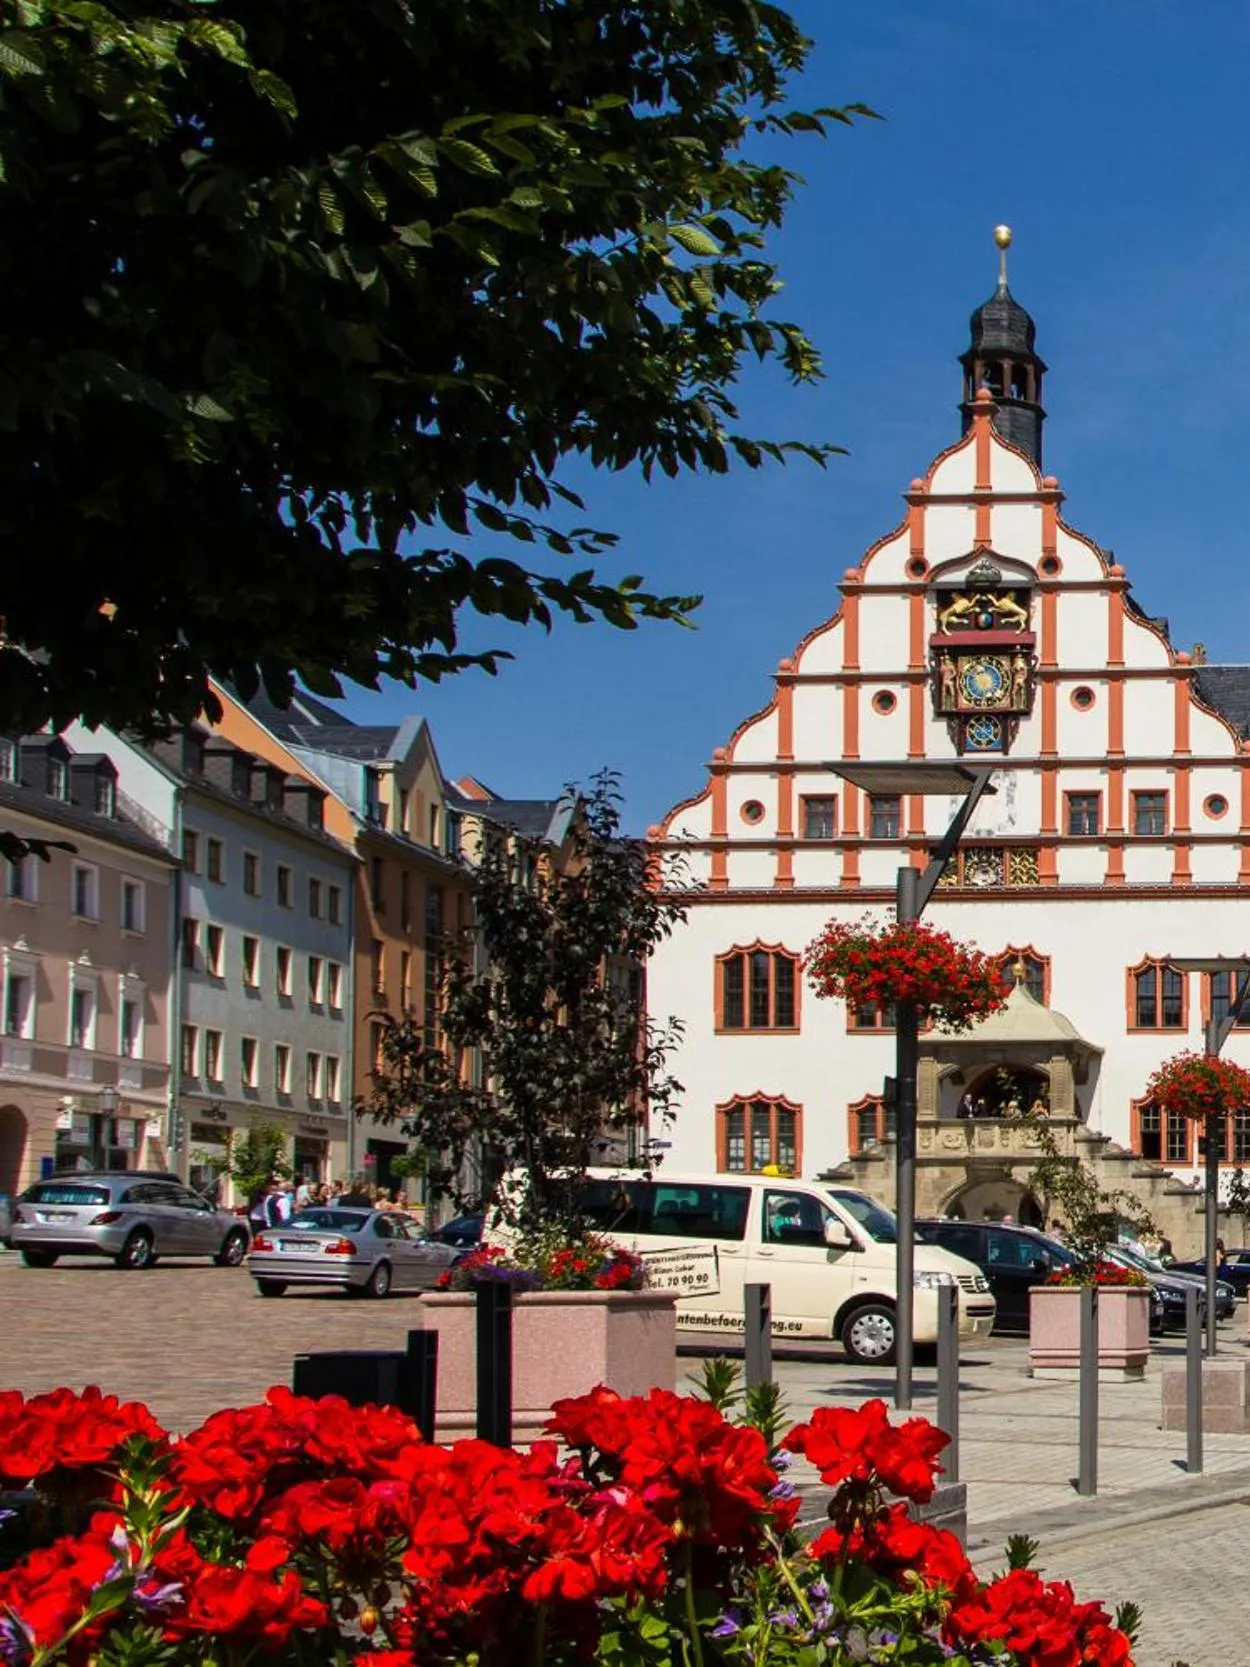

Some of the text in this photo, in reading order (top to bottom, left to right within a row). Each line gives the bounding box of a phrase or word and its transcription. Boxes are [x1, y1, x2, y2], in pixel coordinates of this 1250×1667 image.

[667, 1276, 679, 1287] 70
[681, 1275, 694, 1285] 90
[696, 1273, 709, 1284] 90
